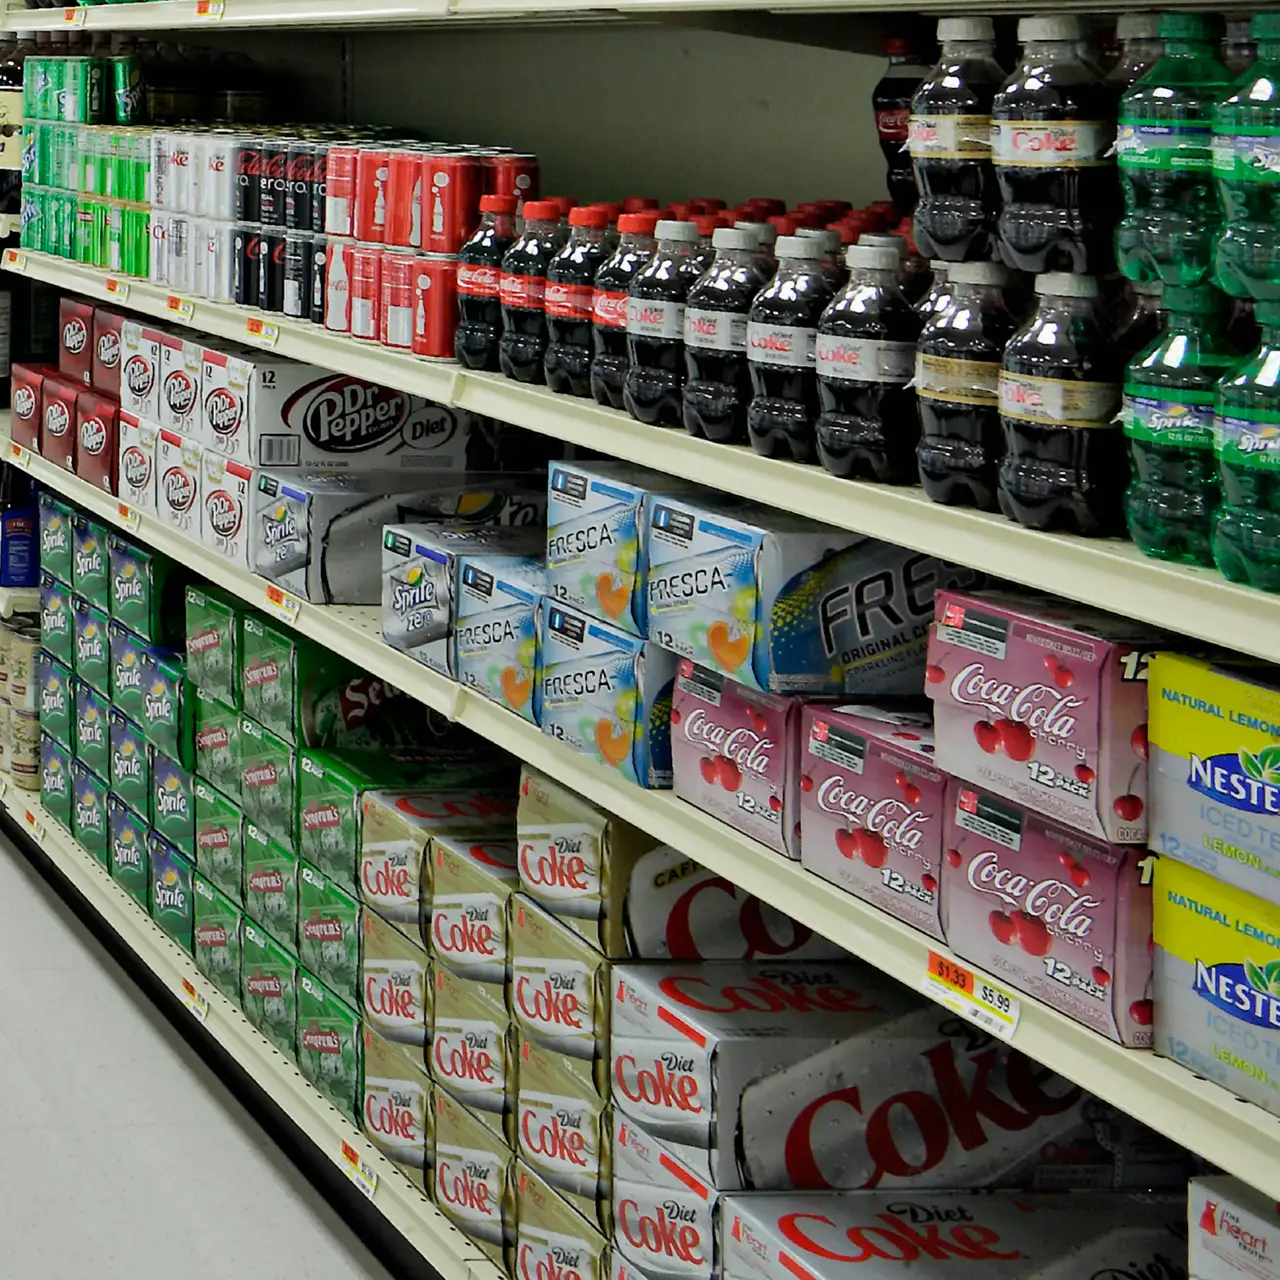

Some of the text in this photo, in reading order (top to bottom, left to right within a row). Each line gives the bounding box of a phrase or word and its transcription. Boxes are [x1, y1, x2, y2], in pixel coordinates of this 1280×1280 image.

[1011, 131, 1078, 152] Coke
[458, 266, 499, 289] Coca-Cola
[749, 331, 793, 351] Coke
[818, 346, 863, 366] Coke
[262, 370, 276, 383] 12
[339, 379, 380, 412] Dr
[319, 392, 403, 442] Pepper
[411, 419, 446, 439] Diet
[1149, 411, 1202, 430] Sprite
[42, 531, 67, 551] Sprite
[264, 518, 296, 547] Sprite
[547, 523, 614, 559] FRESCA
[75, 553, 103, 576] Sprite
[115, 577, 142, 601] Sprite
[390, 582, 436, 612] Sprite
[552, 583, 567, 602] 12
[647, 568, 728, 603] FRESCA
[42, 613, 67, 631] Sprite
[457, 620, 517, 648] FRESCA
[76, 641, 104, 661] Sprite
[657, 631, 674, 651] 12
[841, 631, 910, 665] ORIGINAL
[115, 666, 142, 692] Sprite
[463, 669, 477, 686] 12
[544, 667, 613, 699] FRESCA
[42, 692, 66, 711] Sprite
[143, 695, 173, 722] Sprite
[1161, 686, 1225, 719] NATURAL
[77, 723, 104, 744] Sprite
[549, 723, 565, 742] 12
[1028, 729, 1087, 761] cherry
[114, 756, 142, 781] Sprite
[737, 765, 778, 793] cherry
[1027, 761, 1091, 800] 12 PACK
[1189, 751, 1280, 814] NESTE
[42, 774, 66, 793] Sprite
[76, 807, 102, 827] Sprite
[157, 791, 189, 816] Sprite
[736, 791, 779, 820] 12 PACK
[1200, 803, 1253, 839] ICED
[113, 845, 141, 869] Sprite
[390, 851, 410, 868] Diet
[554, 836, 582, 855] Diet
[883, 840, 932, 870] cherry
[1203, 832, 1261, 870] LEMON
[362, 861, 411, 897] Coke
[520, 843, 588, 892] Coke
[155, 883, 188, 910] Sprite
[880, 868, 934, 906] 12 PACK
[466, 905, 489, 923] Diet
[1167, 890, 1232, 929] NATURAL
[433, 914, 496, 956] Coke
[1045, 924, 1105, 964] cherry
[391, 972, 412, 989] Diet
[550, 973, 577, 992] Diet
[936, 959, 1011, 1014] $1.33 $5.99
[1042, 956, 1107, 1003] 12 PACK
[1194, 957, 1280, 1026] NESTE
[366, 979, 416, 1021] Coke
[516, 976, 584, 1030] Coke
[657, 975, 880, 1015] Coke
[466, 1033, 489, 1050] Diet
[1206, 1010, 1258, 1048] ICED
[435, 1036, 495, 1085] Coke
[662, 1052, 696, 1075] Diet
[1210, 1042, 1268, 1084] LEMON
[615, 1054, 704, 1114] Coke
[392, 1091, 413, 1108] Diet
[366, 1098, 416, 1141] Coke
[557, 1109, 583, 1129] Diet
[521, 1109, 590, 1168] Coke
[466, 1163, 491, 1180] Diet
[439, 1163, 494, 1216] Coke
[662, 1199, 697, 1225] Diet
[886, 1200, 975, 1226] Diet
[618, 1198, 707, 1267] Coke
[777, 1209, 1020, 1263] Coke
[1219, 1209, 1269, 1254] heart
[551, 1246, 581, 1269] Diet
